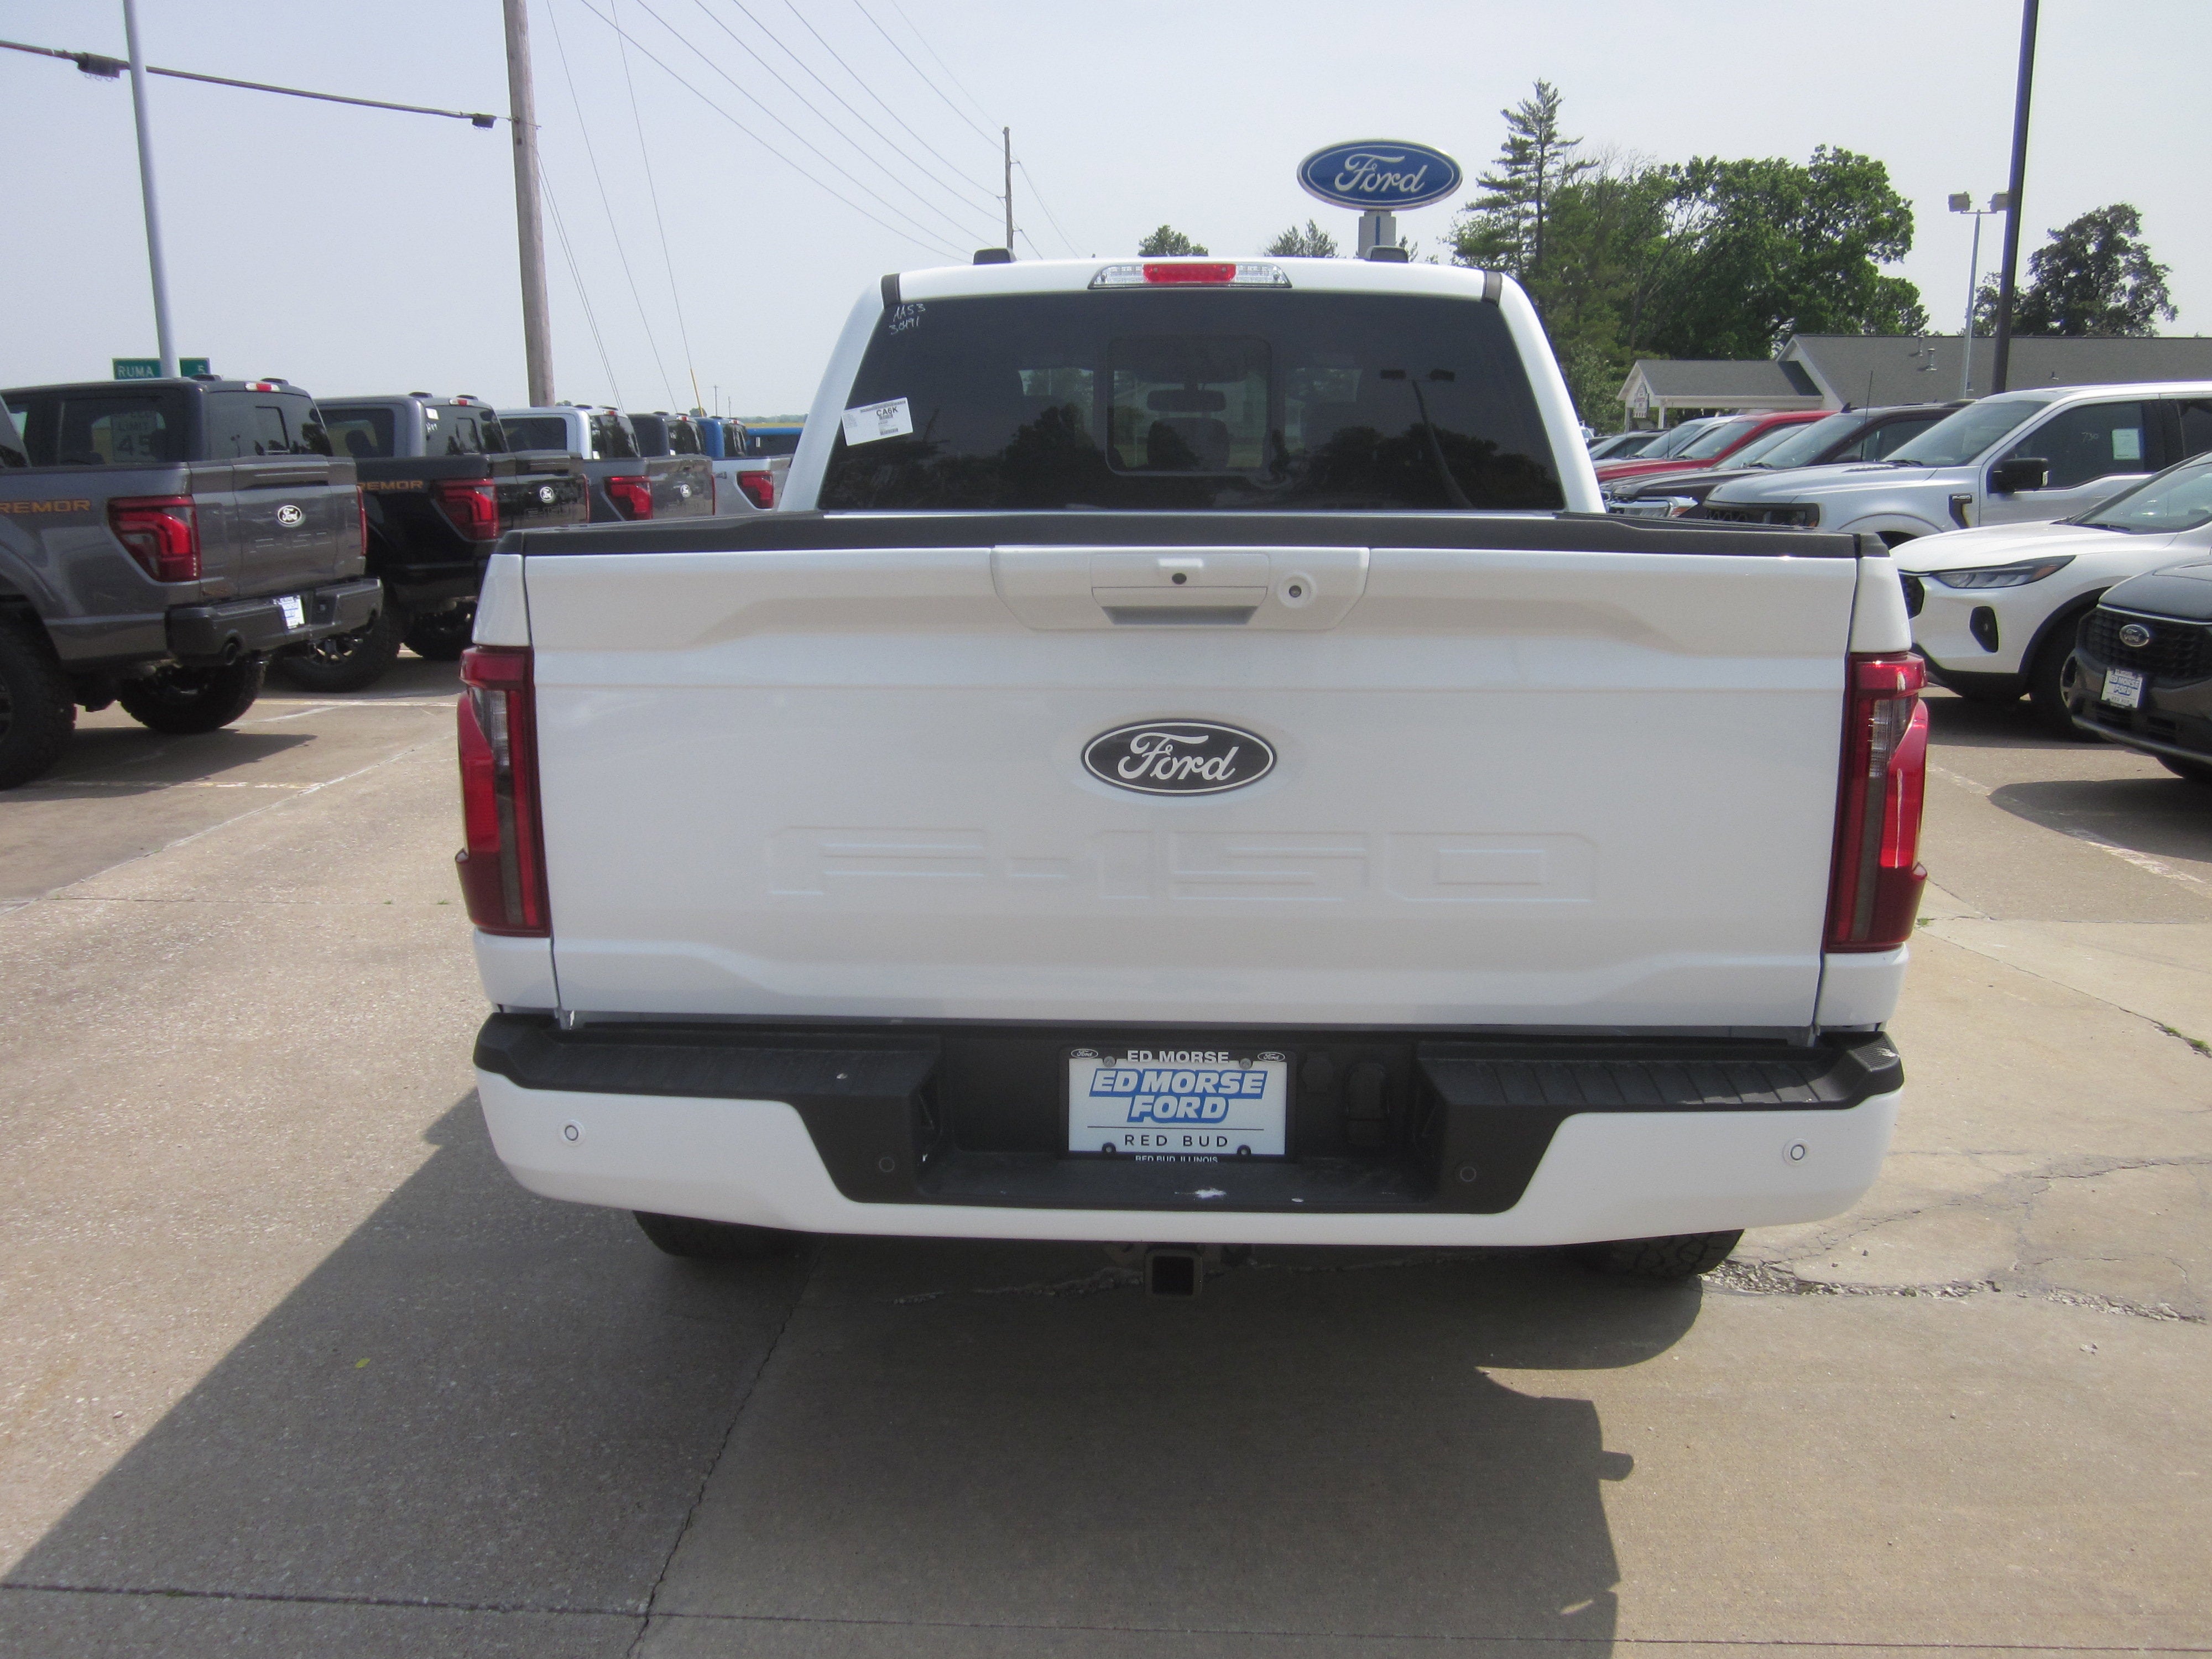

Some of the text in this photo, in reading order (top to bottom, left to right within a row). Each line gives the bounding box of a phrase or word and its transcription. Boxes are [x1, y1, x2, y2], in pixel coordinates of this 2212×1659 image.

[1334, 153, 1428, 192] Ford
[117, 366, 155, 378] RUMA
[876, 406, 899, 416] CA6K
[282, 508, 298, 521] Ford
[1117, 732, 1239, 781] Ford
[765, 825, 1599, 904] F-150
[1076, 1050, 1093, 1058] Ford
[1127, 1050, 1229, 1063] ED MORSE
[1091, 1070, 1266, 1095] ED MORSE
[1129, 1094, 1228, 1119] FORD
[1124, 1134, 1228, 1147] RED BUD
